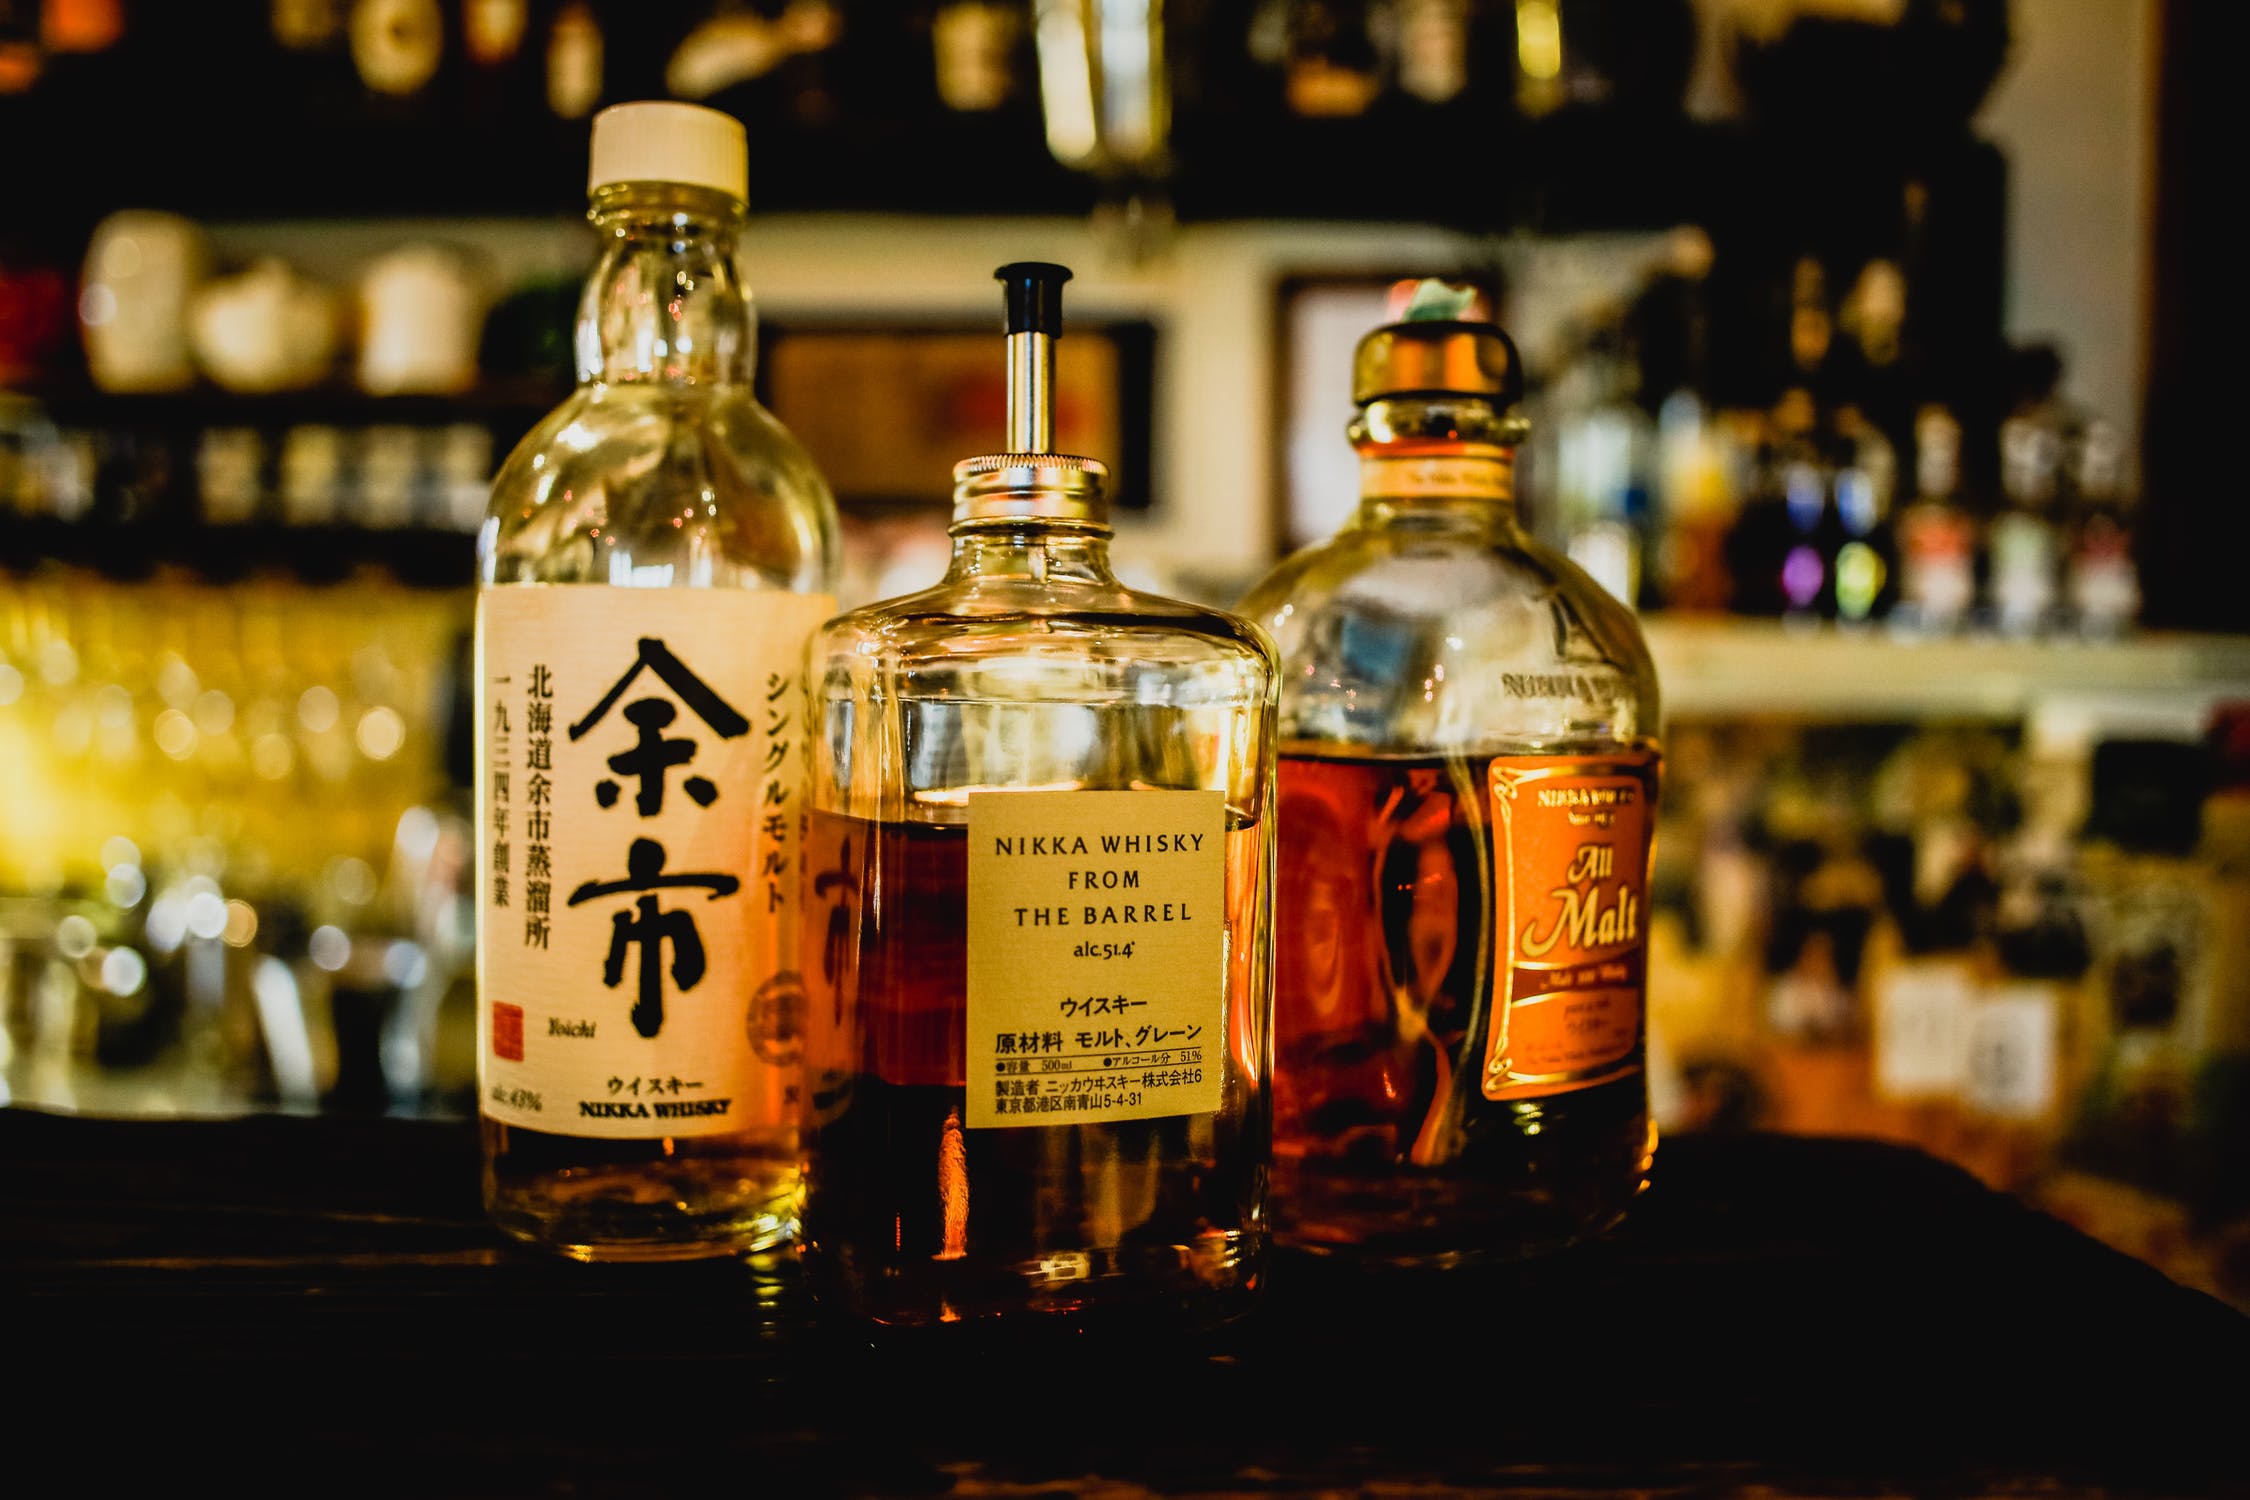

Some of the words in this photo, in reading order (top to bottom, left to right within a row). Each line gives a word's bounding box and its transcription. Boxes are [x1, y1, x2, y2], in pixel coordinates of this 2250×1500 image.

[761, 672, 790, 914] シングルモルト
[568, 636, 750, 1039] 余市
[995, 837, 1088, 856] NIKKA
[1101, 833, 1204, 854] WHISKY
[1566, 844, 1614, 884] All
[1068, 870, 1140, 890] FROM
[1014, 907, 1070, 927] THE
[1083, 903, 1192, 925] BARREL
[1520, 885, 1638, 958] Malt
[1060, 995, 1148, 1018] ウイスキー
[548, 1016, 597, 1039] Yoichi
[995, 1031, 1064, 1055] 原材料
[1180, 1049, 1202, 1063] 51%
[607, 1075, 704, 1097] ウイスキー
[995, 1080, 1040, 1097] 製造者
[579, 1101, 650, 1119] NIKKA
[654, 1098, 731, 1117] WHISKY
